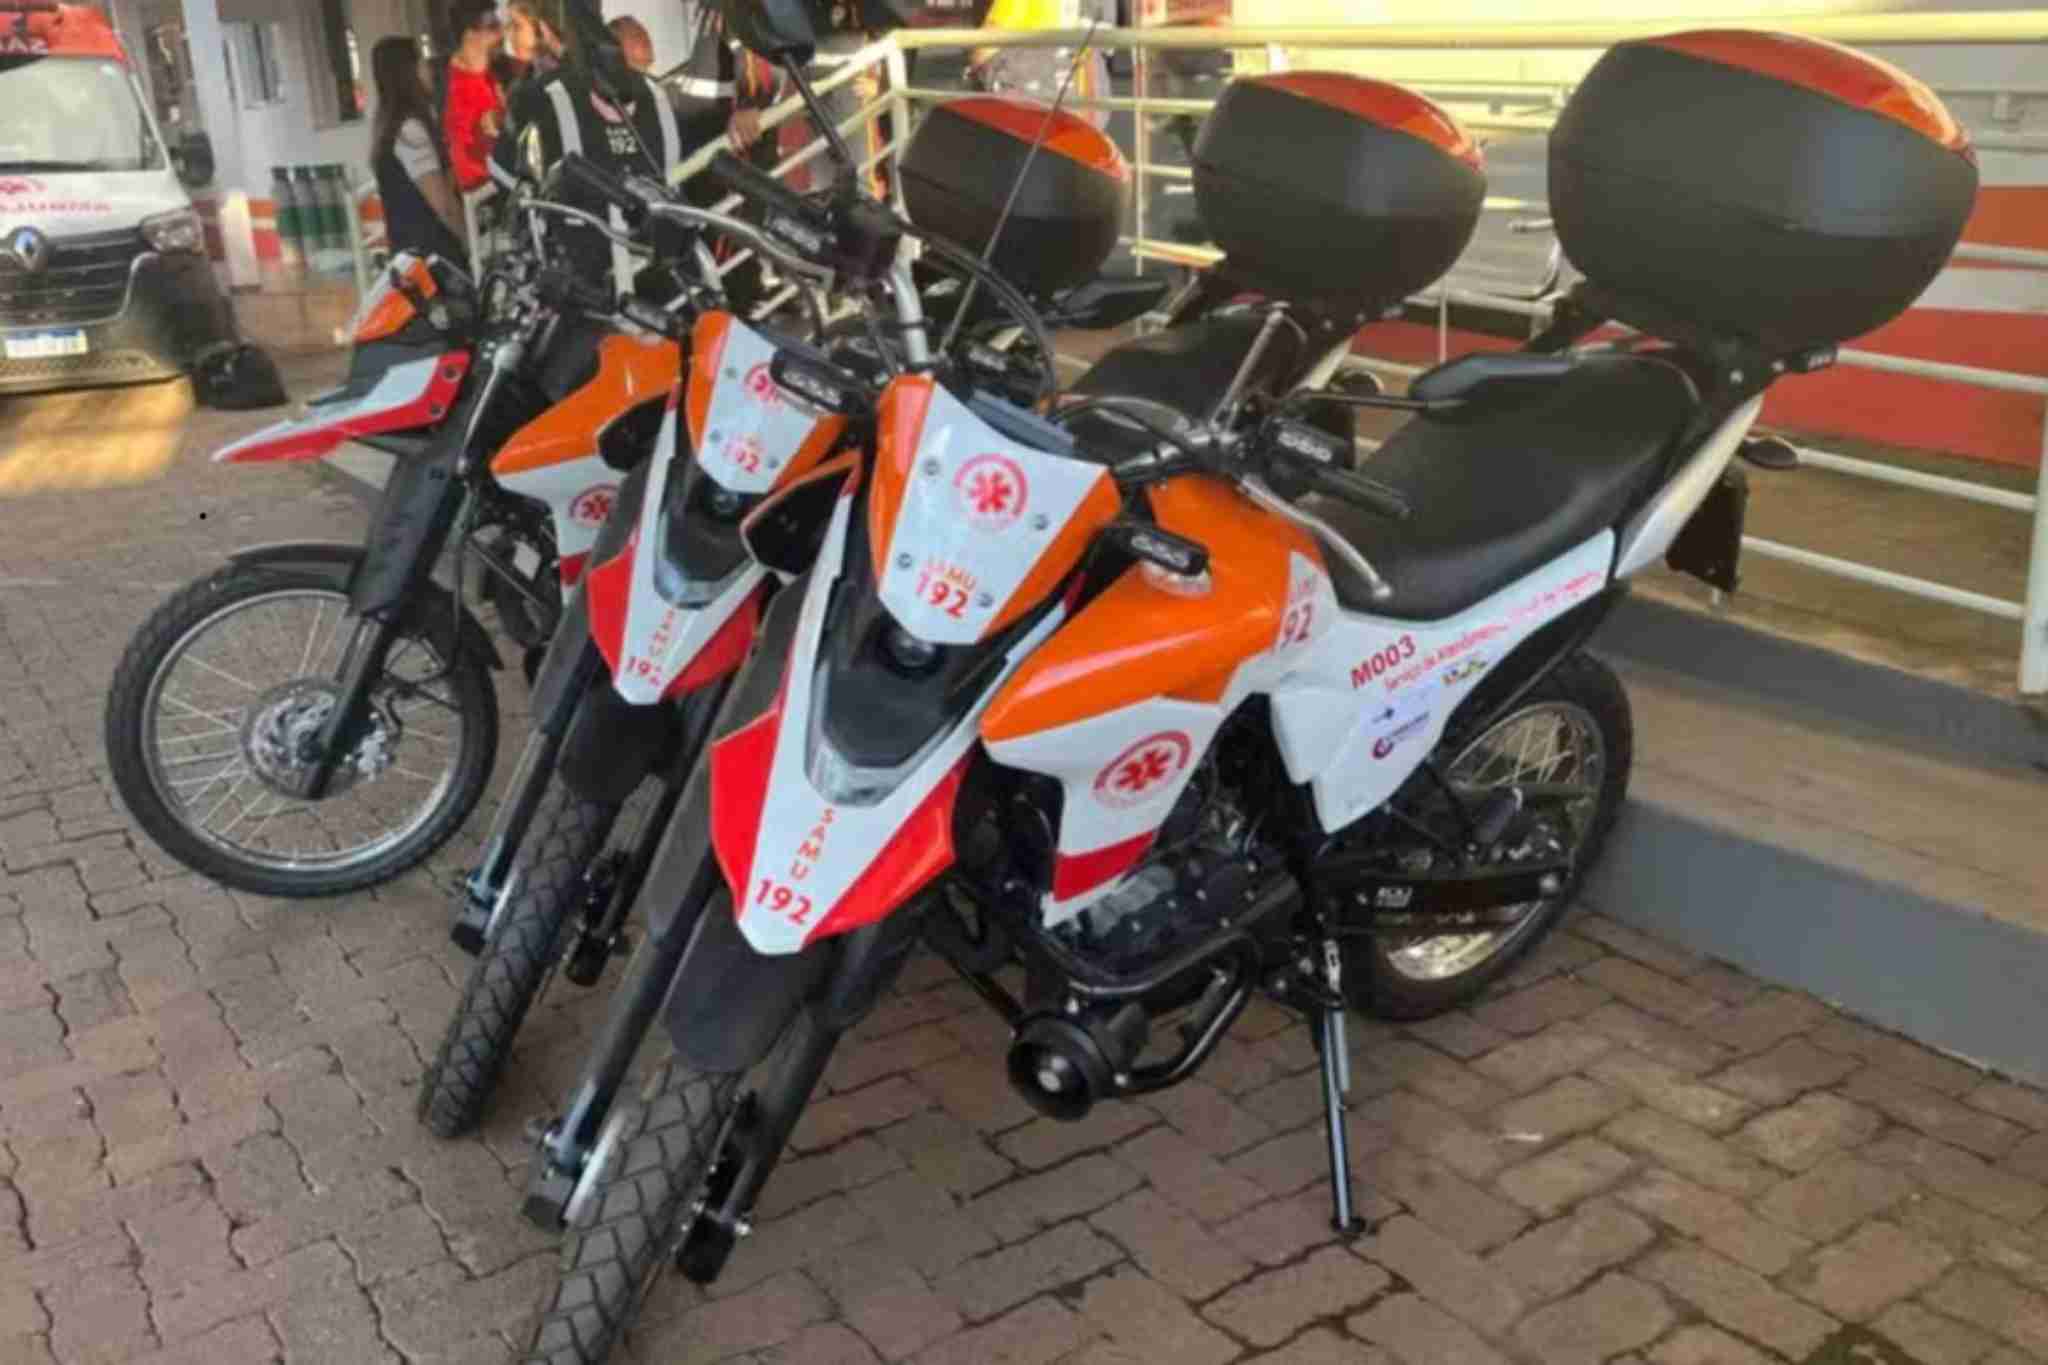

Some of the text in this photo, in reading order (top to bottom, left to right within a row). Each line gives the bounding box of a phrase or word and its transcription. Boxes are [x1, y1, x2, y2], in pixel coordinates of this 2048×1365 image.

[914, 570, 970, 620] 192
[1350, 633, 1416, 690] M003
[789, 806, 834, 880] SAMU
[756, 878, 812, 925] 192
